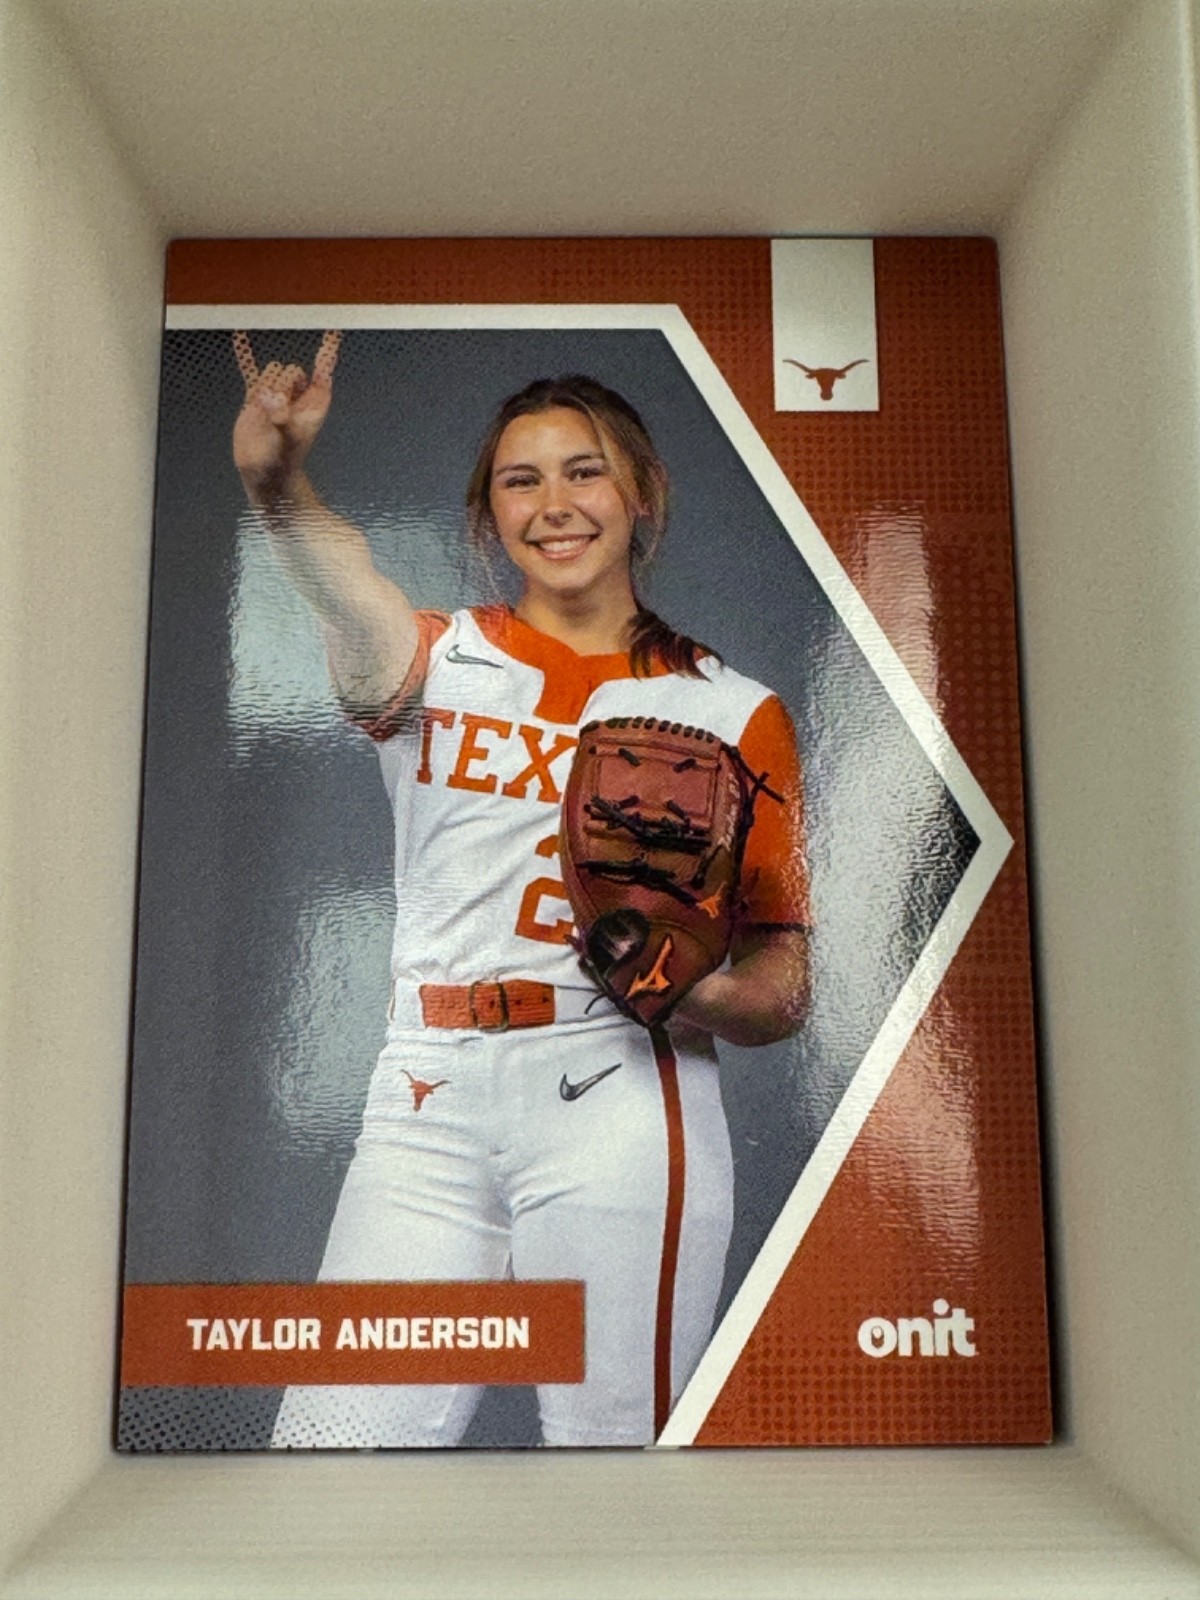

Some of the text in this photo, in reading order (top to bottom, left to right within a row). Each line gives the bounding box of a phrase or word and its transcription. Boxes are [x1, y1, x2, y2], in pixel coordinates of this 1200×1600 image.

[186, 1316, 530, 1351] TAYLOR ANDERSON
[857, 1298, 977, 1358] onit
